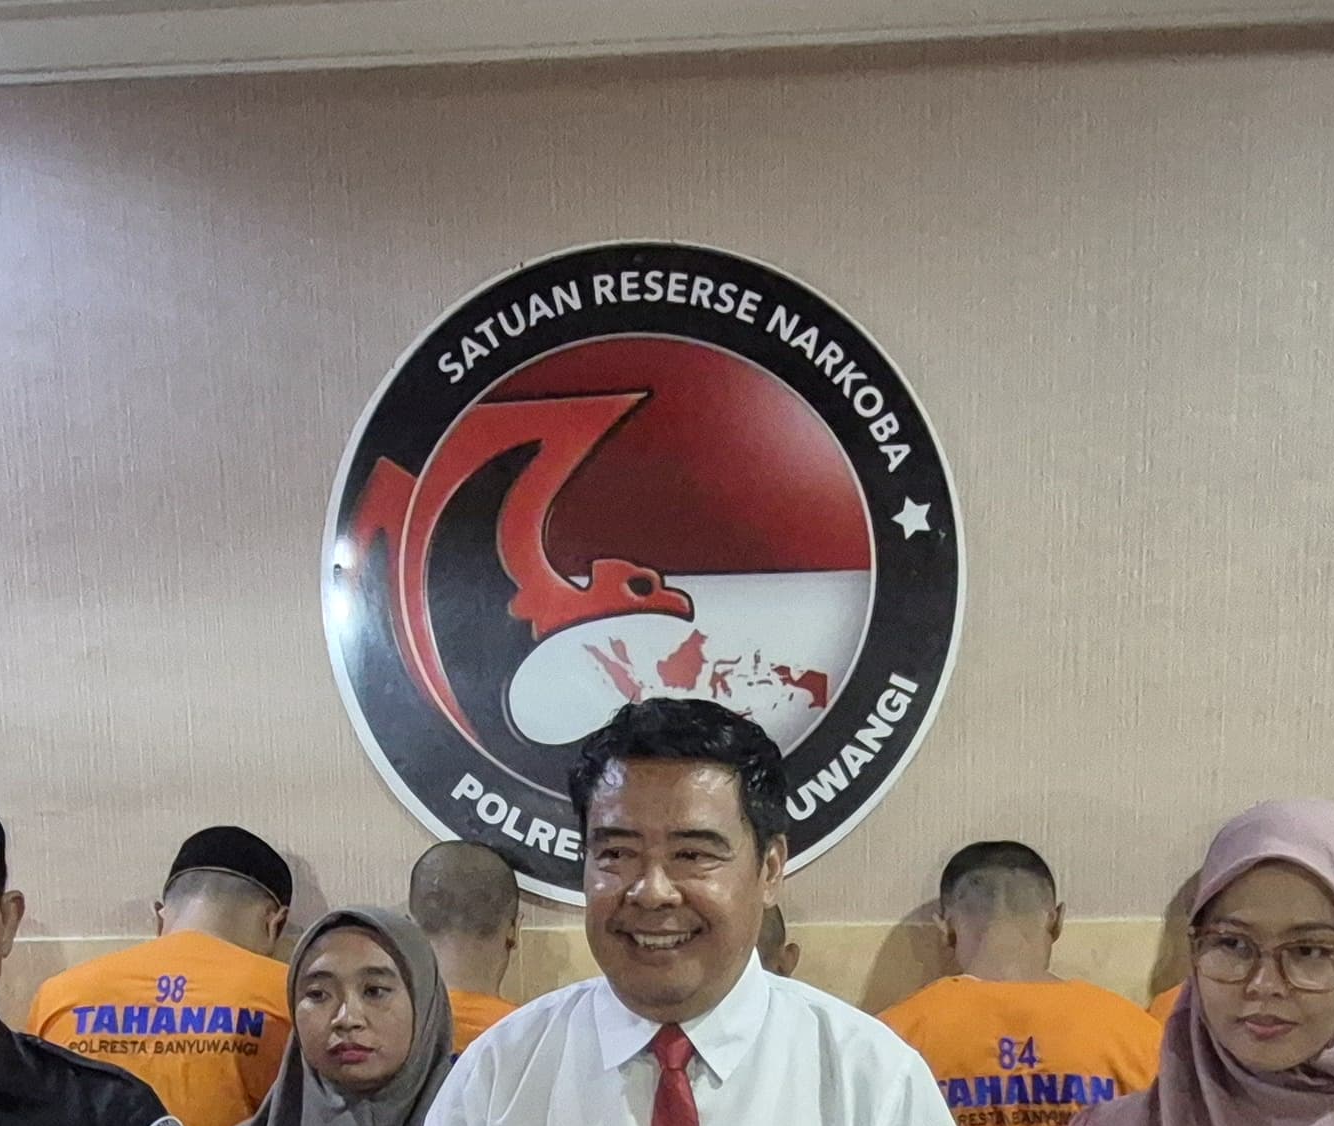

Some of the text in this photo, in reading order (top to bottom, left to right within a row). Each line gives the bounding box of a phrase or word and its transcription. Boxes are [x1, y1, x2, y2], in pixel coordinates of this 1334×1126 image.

[438, 270, 912, 474] SATUAN RESERSE NARKOBA
[451, 672, 919, 862] POLRE UWANGI
[156, 975, 187, 1003] 98
[72, 1005, 265, 1037] TAHANAN
[69, 1039, 259, 1056] POLRESTA BANYUWANGI
[999, 1036, 1038, 1070] 84
[957, 1110, 1005, 1126] RESTA
